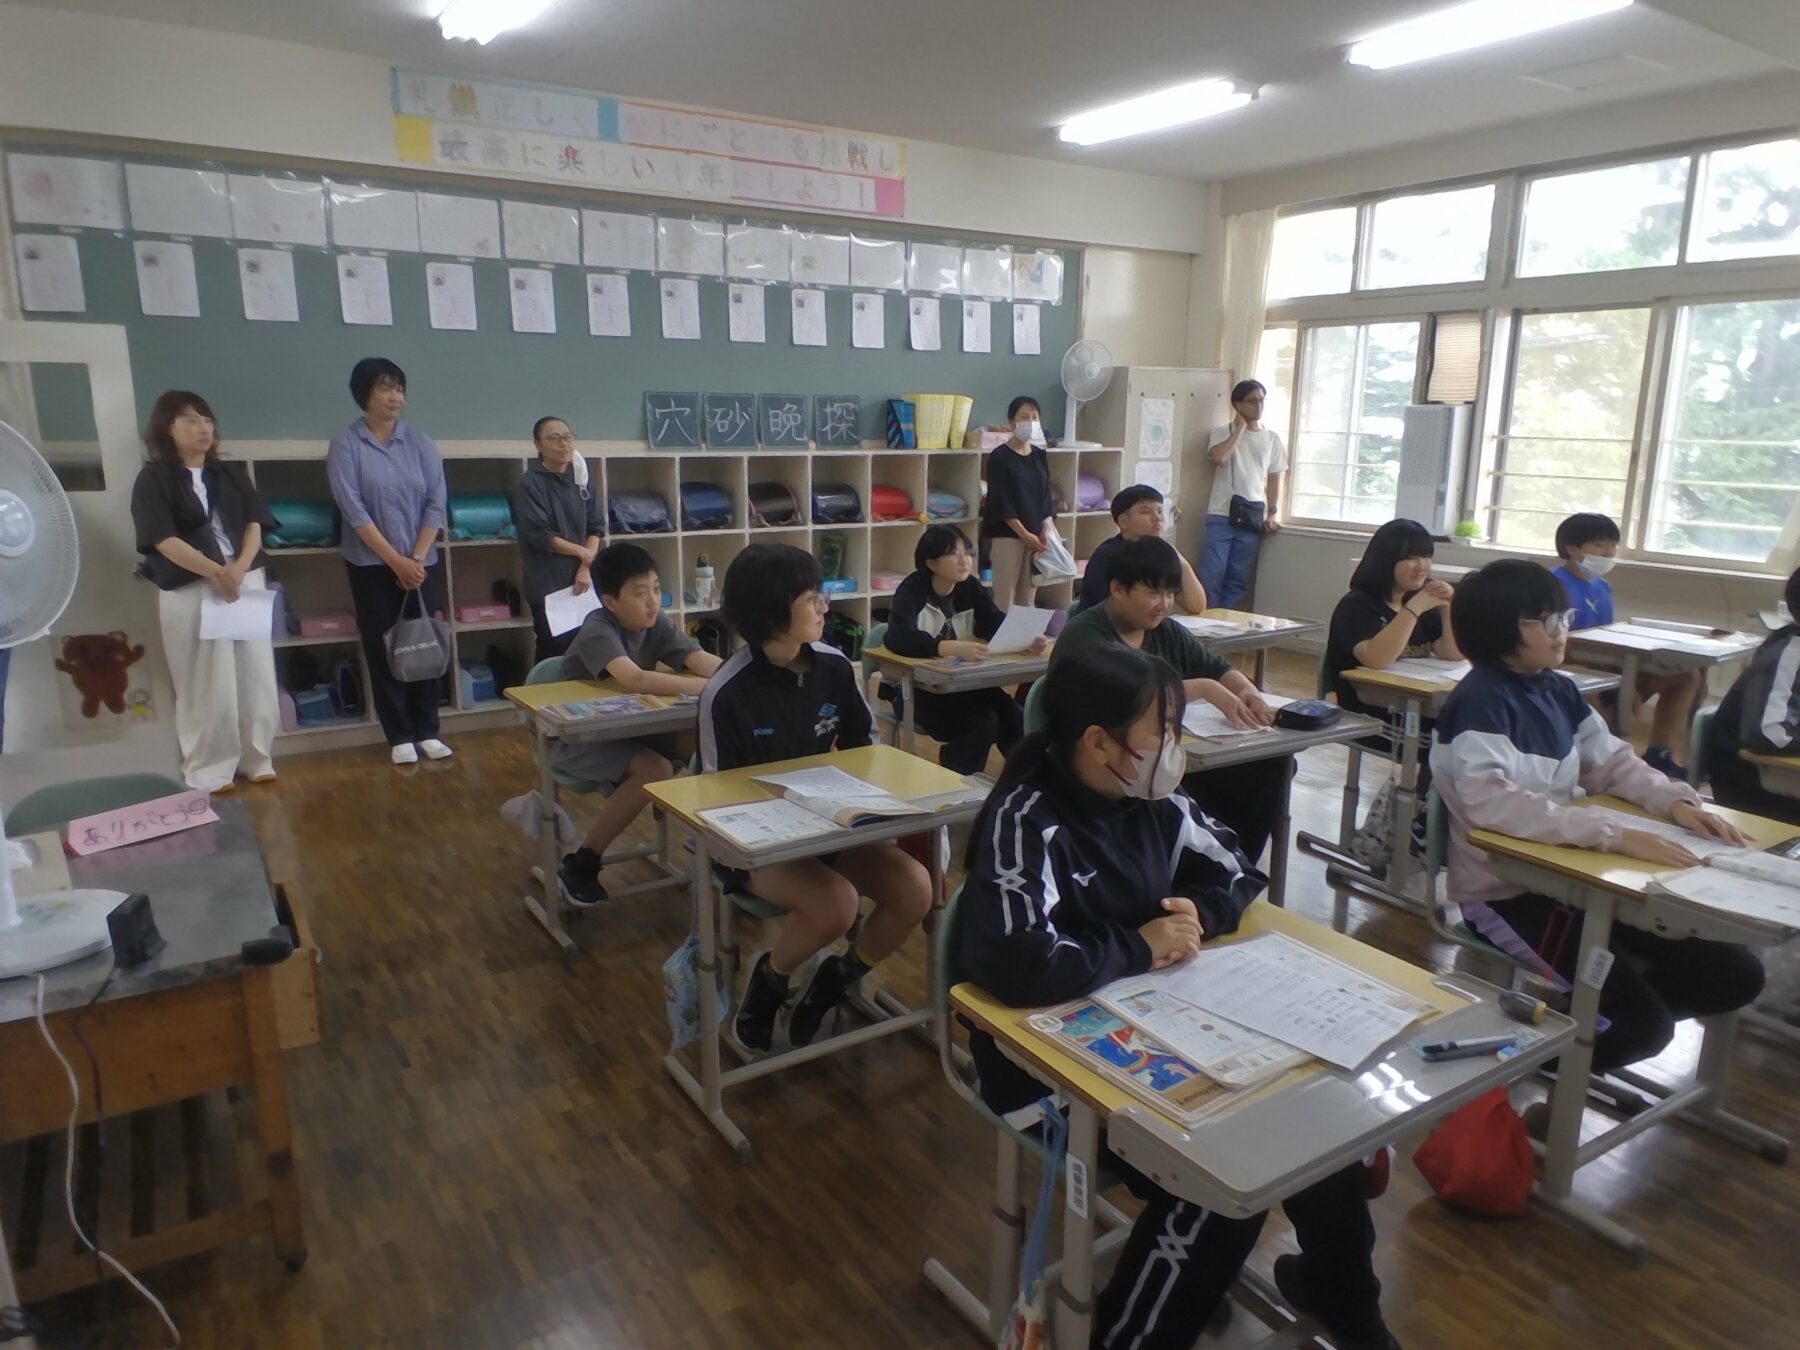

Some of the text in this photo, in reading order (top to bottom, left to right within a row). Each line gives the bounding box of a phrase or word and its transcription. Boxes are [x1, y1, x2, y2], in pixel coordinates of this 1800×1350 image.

[654, 398, 858, 445] 穴 砂 晩 探
[82, 803, 188, 846] ありがとう
